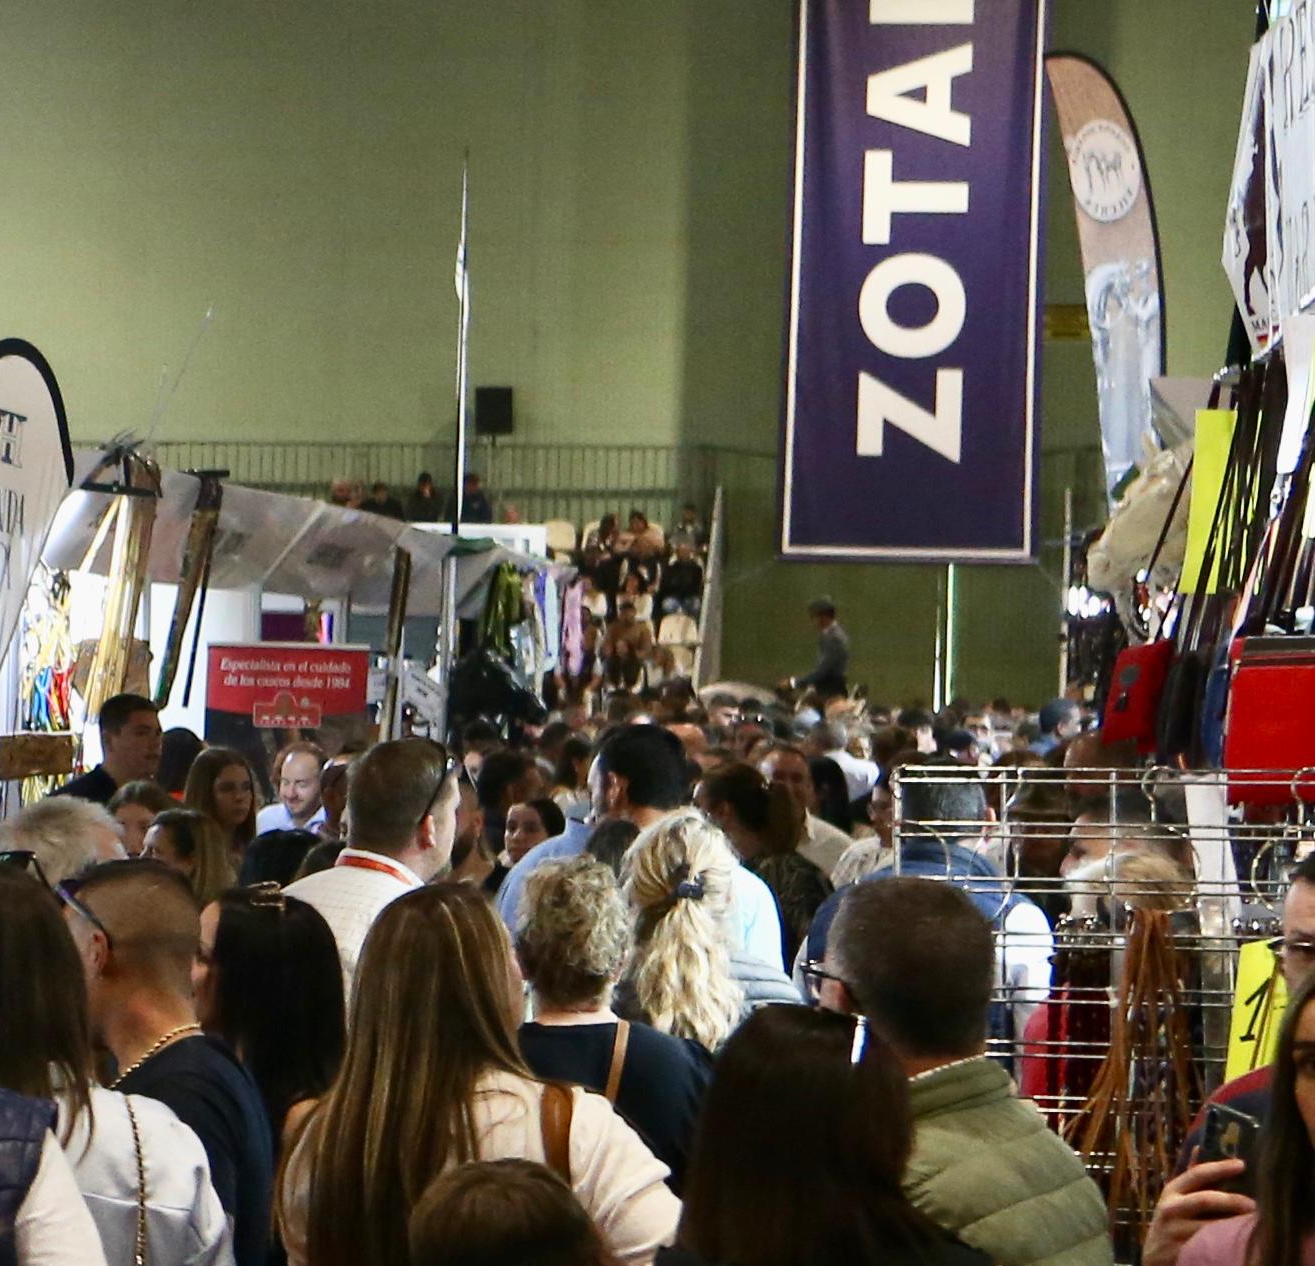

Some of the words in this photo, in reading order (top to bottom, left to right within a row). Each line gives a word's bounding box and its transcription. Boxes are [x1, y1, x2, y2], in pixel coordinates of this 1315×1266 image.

[220, 658, 281, 673] Especialista
[283, 661, 297, 673] en
[298, 660, 309, 673] el
[309, 661, 352, 674] cuidado
[223, 674, 237, 686] de
[239, 674, 255, 686] los
[293, 675, 323, 688] desde
